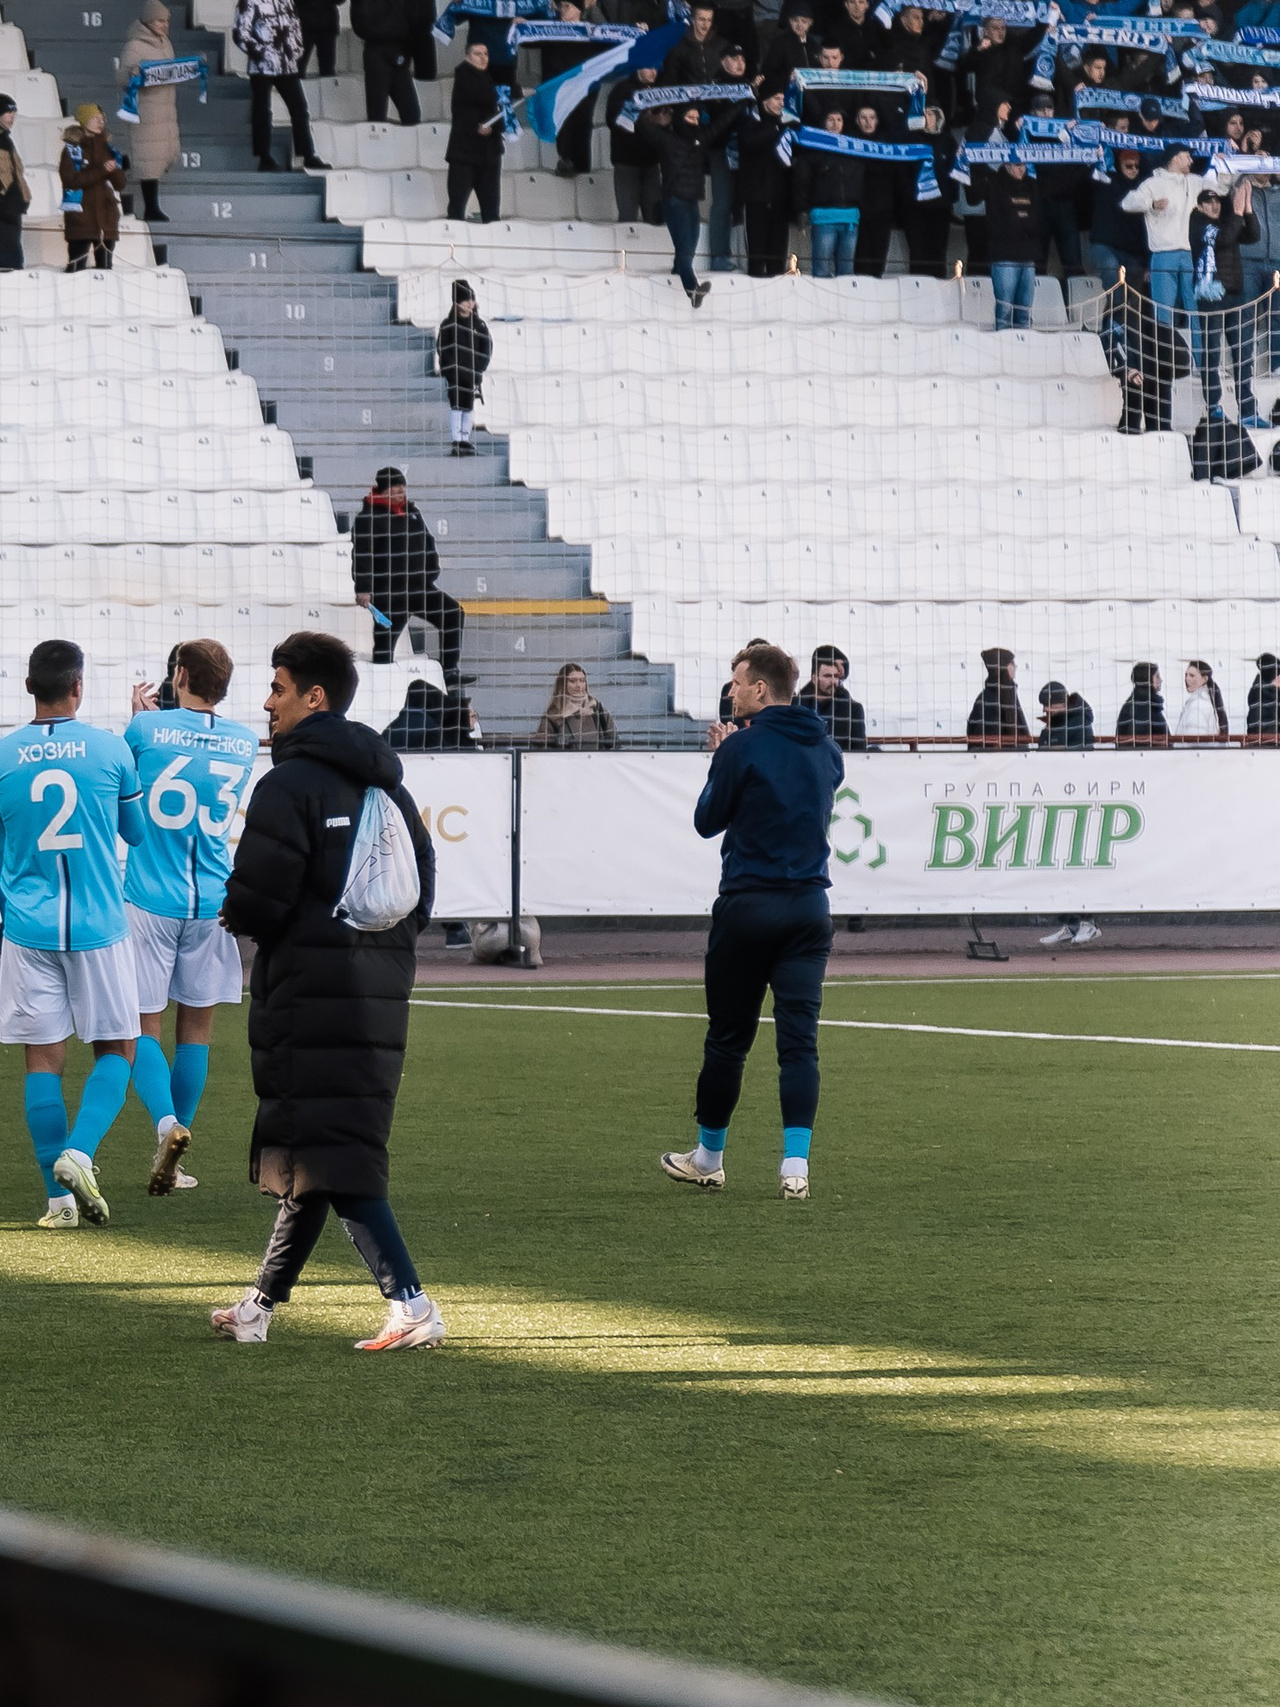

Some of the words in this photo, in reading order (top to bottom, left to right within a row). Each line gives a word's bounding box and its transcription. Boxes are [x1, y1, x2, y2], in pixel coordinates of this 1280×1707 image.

[83, 12, 101, 26] 16
[182, 153, 200, 167] 13
[212, 203, 232, 218] 12
[250, 253, 266, 268] 11
[286, 304, 305, 319] 10
[324, 357, 334, 371] 9
[477, 577, 487, 592] 5
[515, 637, 525, 652] 4
[153, 727, 253, 757] НИКИТЕНКОВ
[17, 740, 88, 765] ХОЗИН
[148, 755, 246, 838] 63
[924, 782, 1044, 798] ГРУППА
[1063, 780, 1147, 797] ФИРМ
[30, 768, 84, 852] 2
[924, 801, 1147, 871] ВИПР
